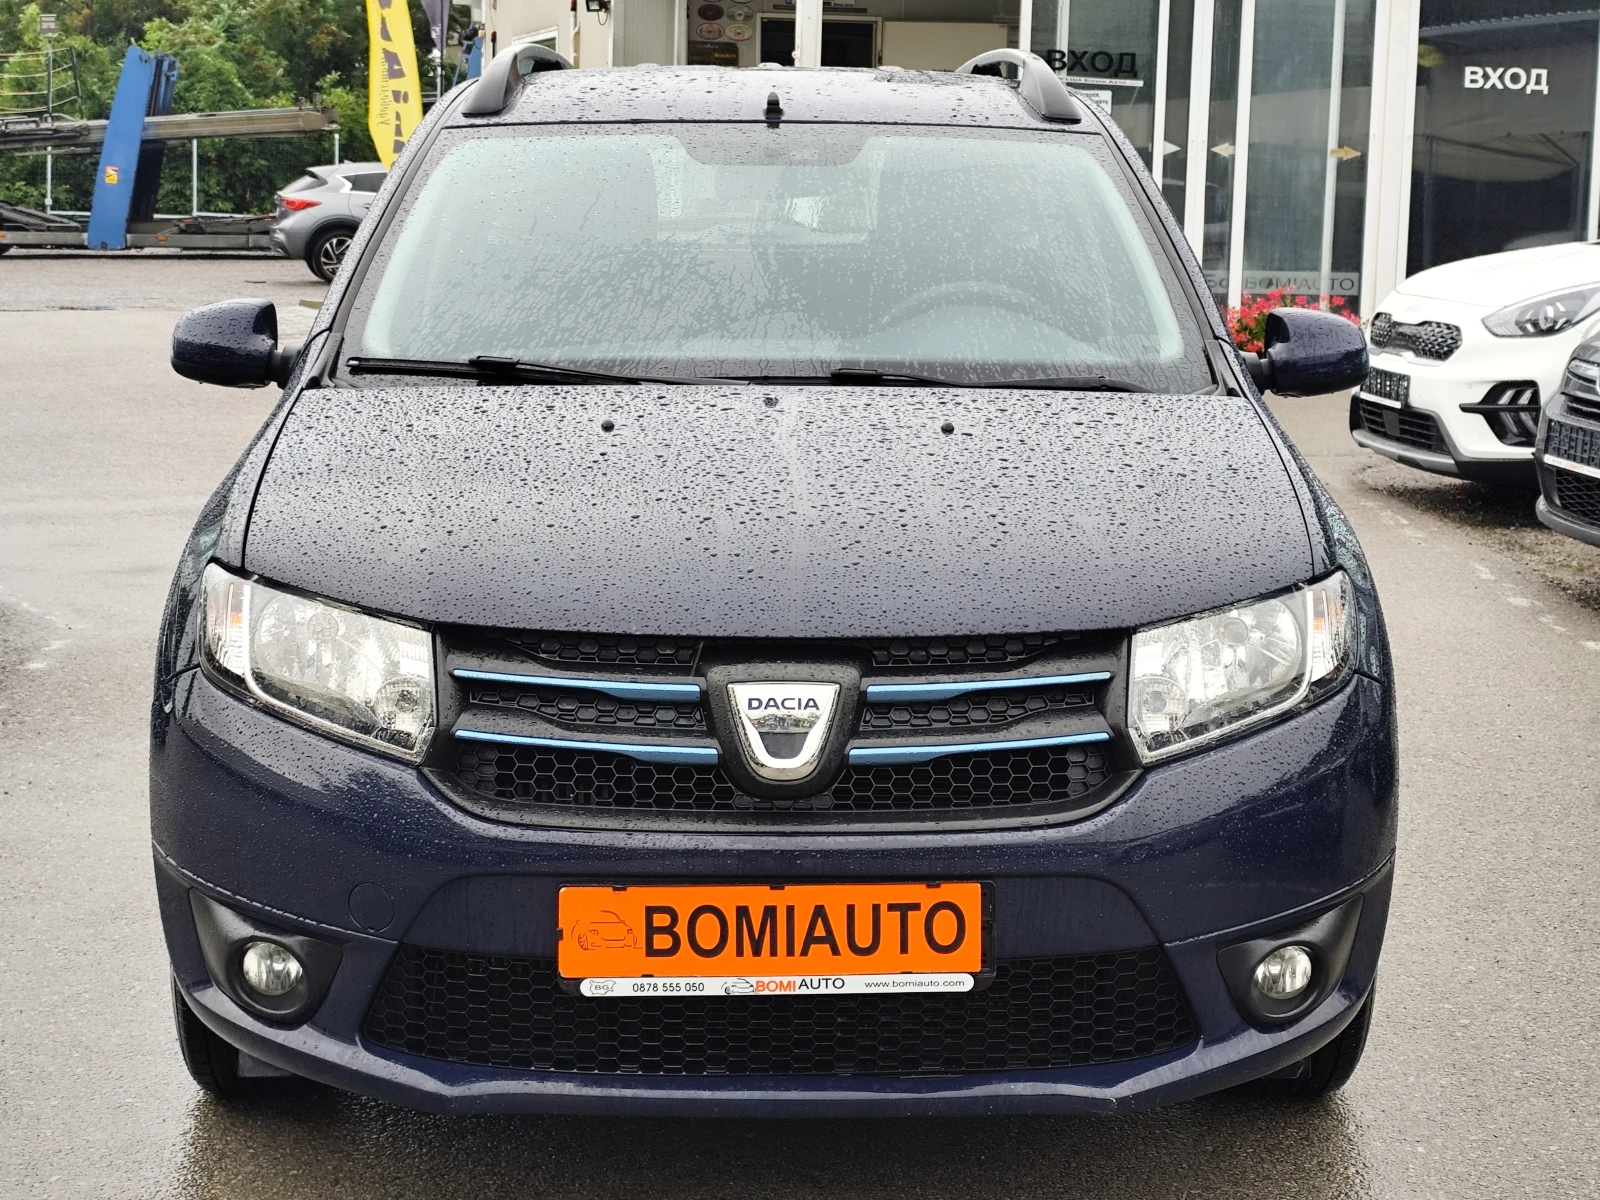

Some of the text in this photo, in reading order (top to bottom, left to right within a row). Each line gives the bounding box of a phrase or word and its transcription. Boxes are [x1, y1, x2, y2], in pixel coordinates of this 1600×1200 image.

[1047, 49, 1137, 77] ВХОД
[1464, 65, 1549, 95] ВХОД
[747, 697, 820, 711] DACIA
[644, 900, 967, 958] BOMIAUTO
[632, 982, 705, 993] 0878 555 050
[864, 979, 965, 989] www.bomiauto.com
